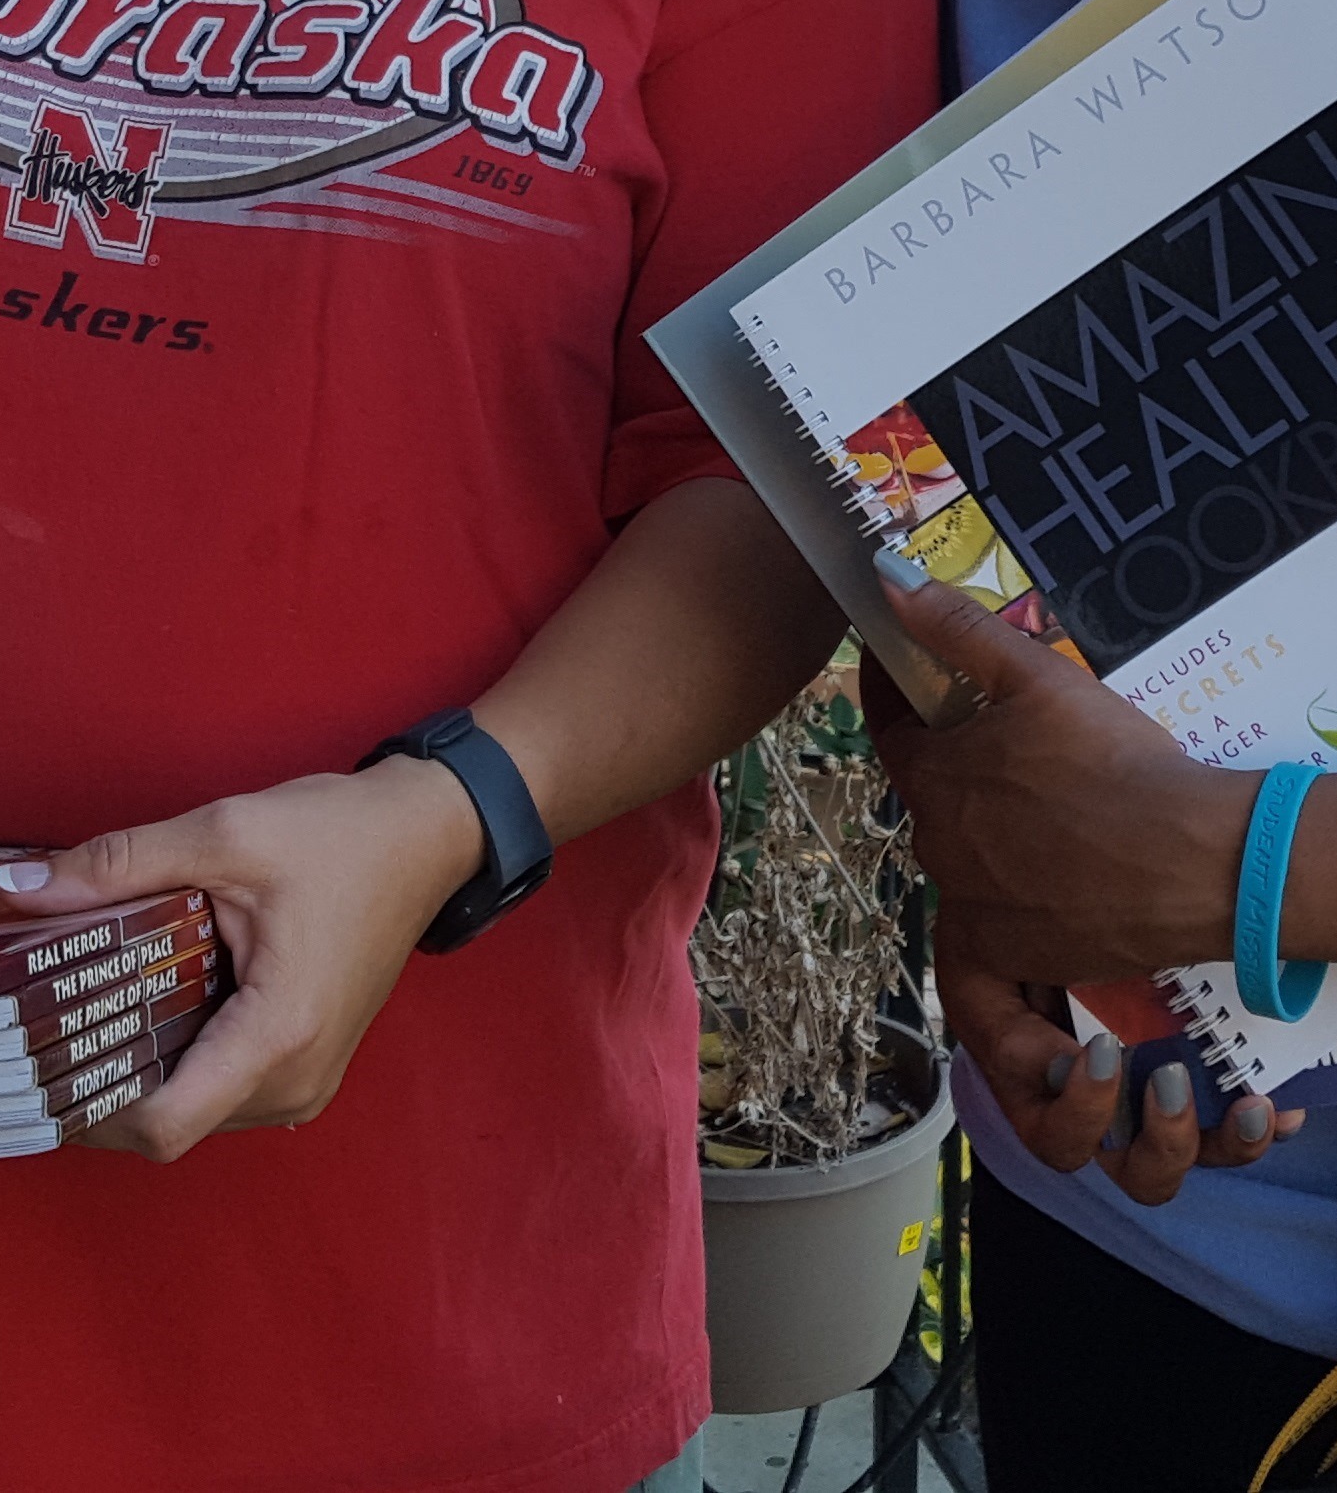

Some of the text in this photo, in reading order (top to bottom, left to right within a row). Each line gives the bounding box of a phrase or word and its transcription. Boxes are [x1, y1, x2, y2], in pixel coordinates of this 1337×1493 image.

[22, 128, 160, 219] Huskers
[451, 154, 534, 197] 1869
[824, 130, 1062, 305] BARBARA
[1125, 629, 1233, 707] NCLUDES
[1155, 633, 1286, 732] ECRETS
[1213, 714, 1230, 733] A
[27, 923, 113, 976] REAL HEROES
[52, 934, 174, 1003] THE PRINCE OF PEACE
[60, 966, 179, 1038] THE PRINCE OF PEACE
[70, 1010, 141, 1064] REAL HEROES
[71, 1050, 134, 1104] STORYTIME
[85, 1074, 142, 1129] STORYTIME
